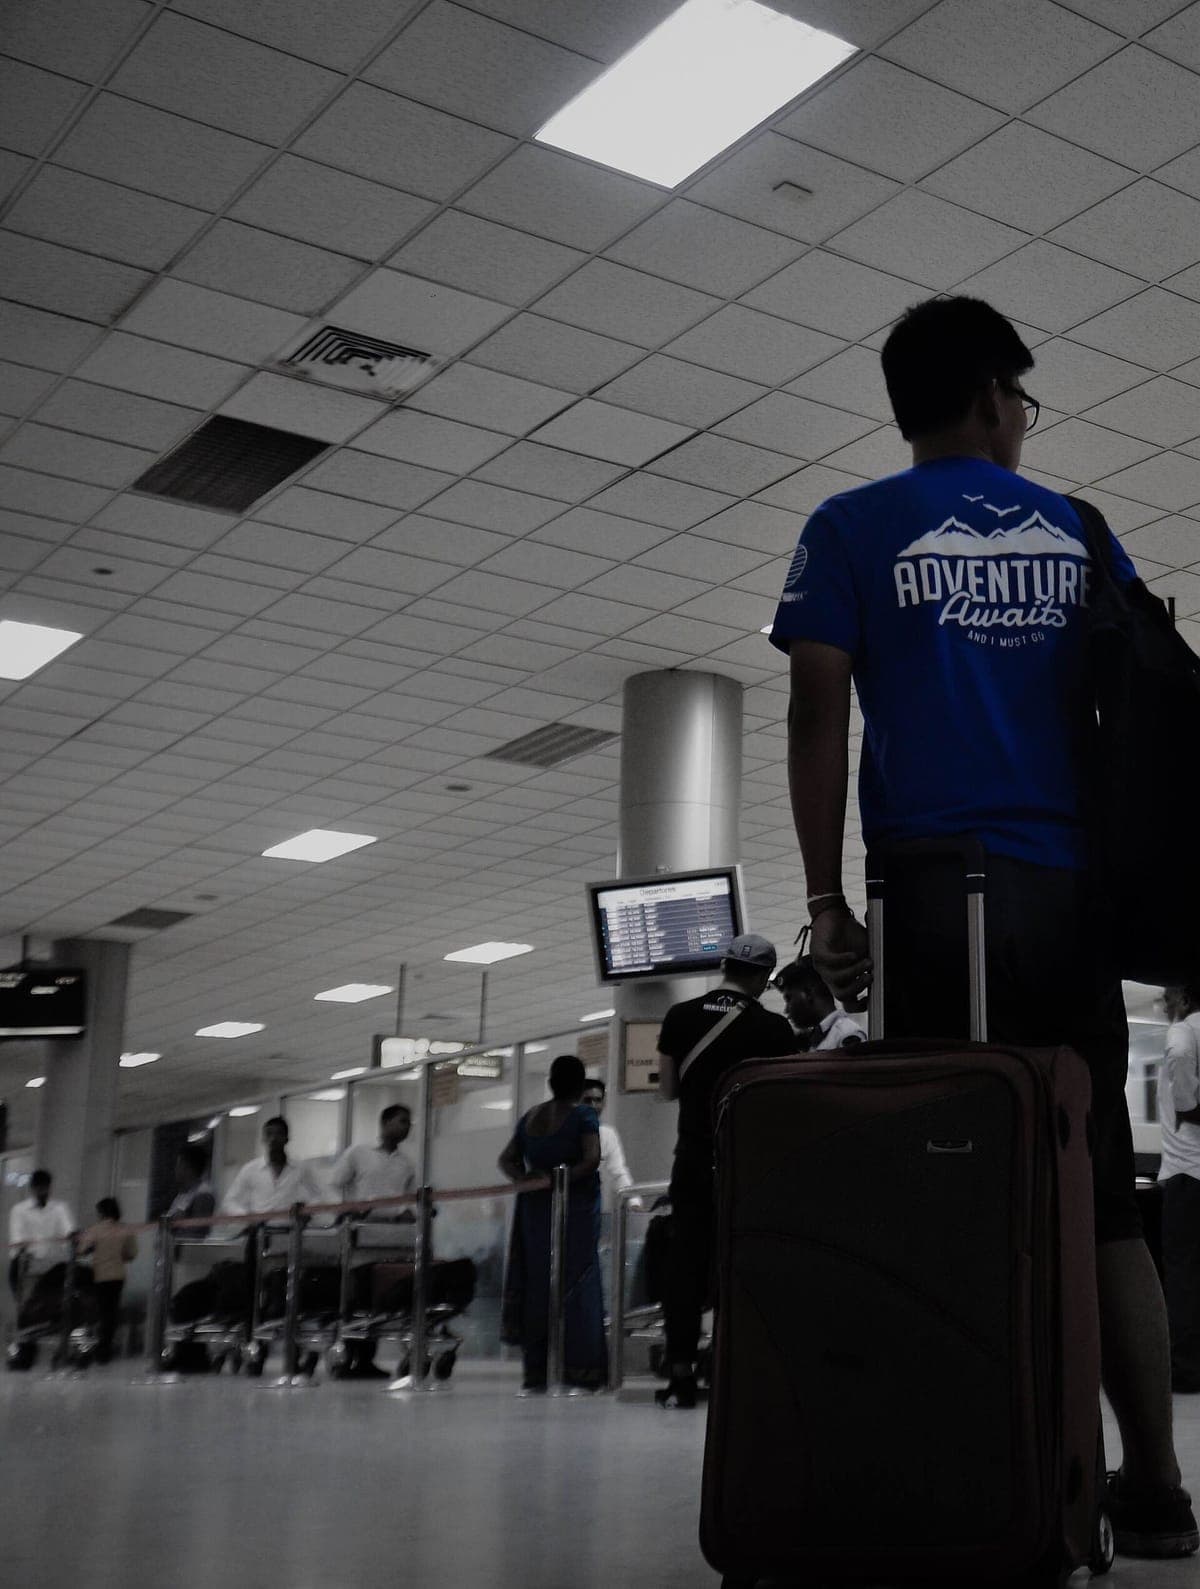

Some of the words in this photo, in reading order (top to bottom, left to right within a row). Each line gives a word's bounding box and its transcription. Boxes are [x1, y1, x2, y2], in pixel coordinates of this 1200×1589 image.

[893, 558, 1092, 608] ADVENTURE
[938, 591, 1067, 627] Awaits
[967, 630, 987, 644] AND
[999, 636, 1026, 648] MUST
[1031, 631, 1045, 643] GO
